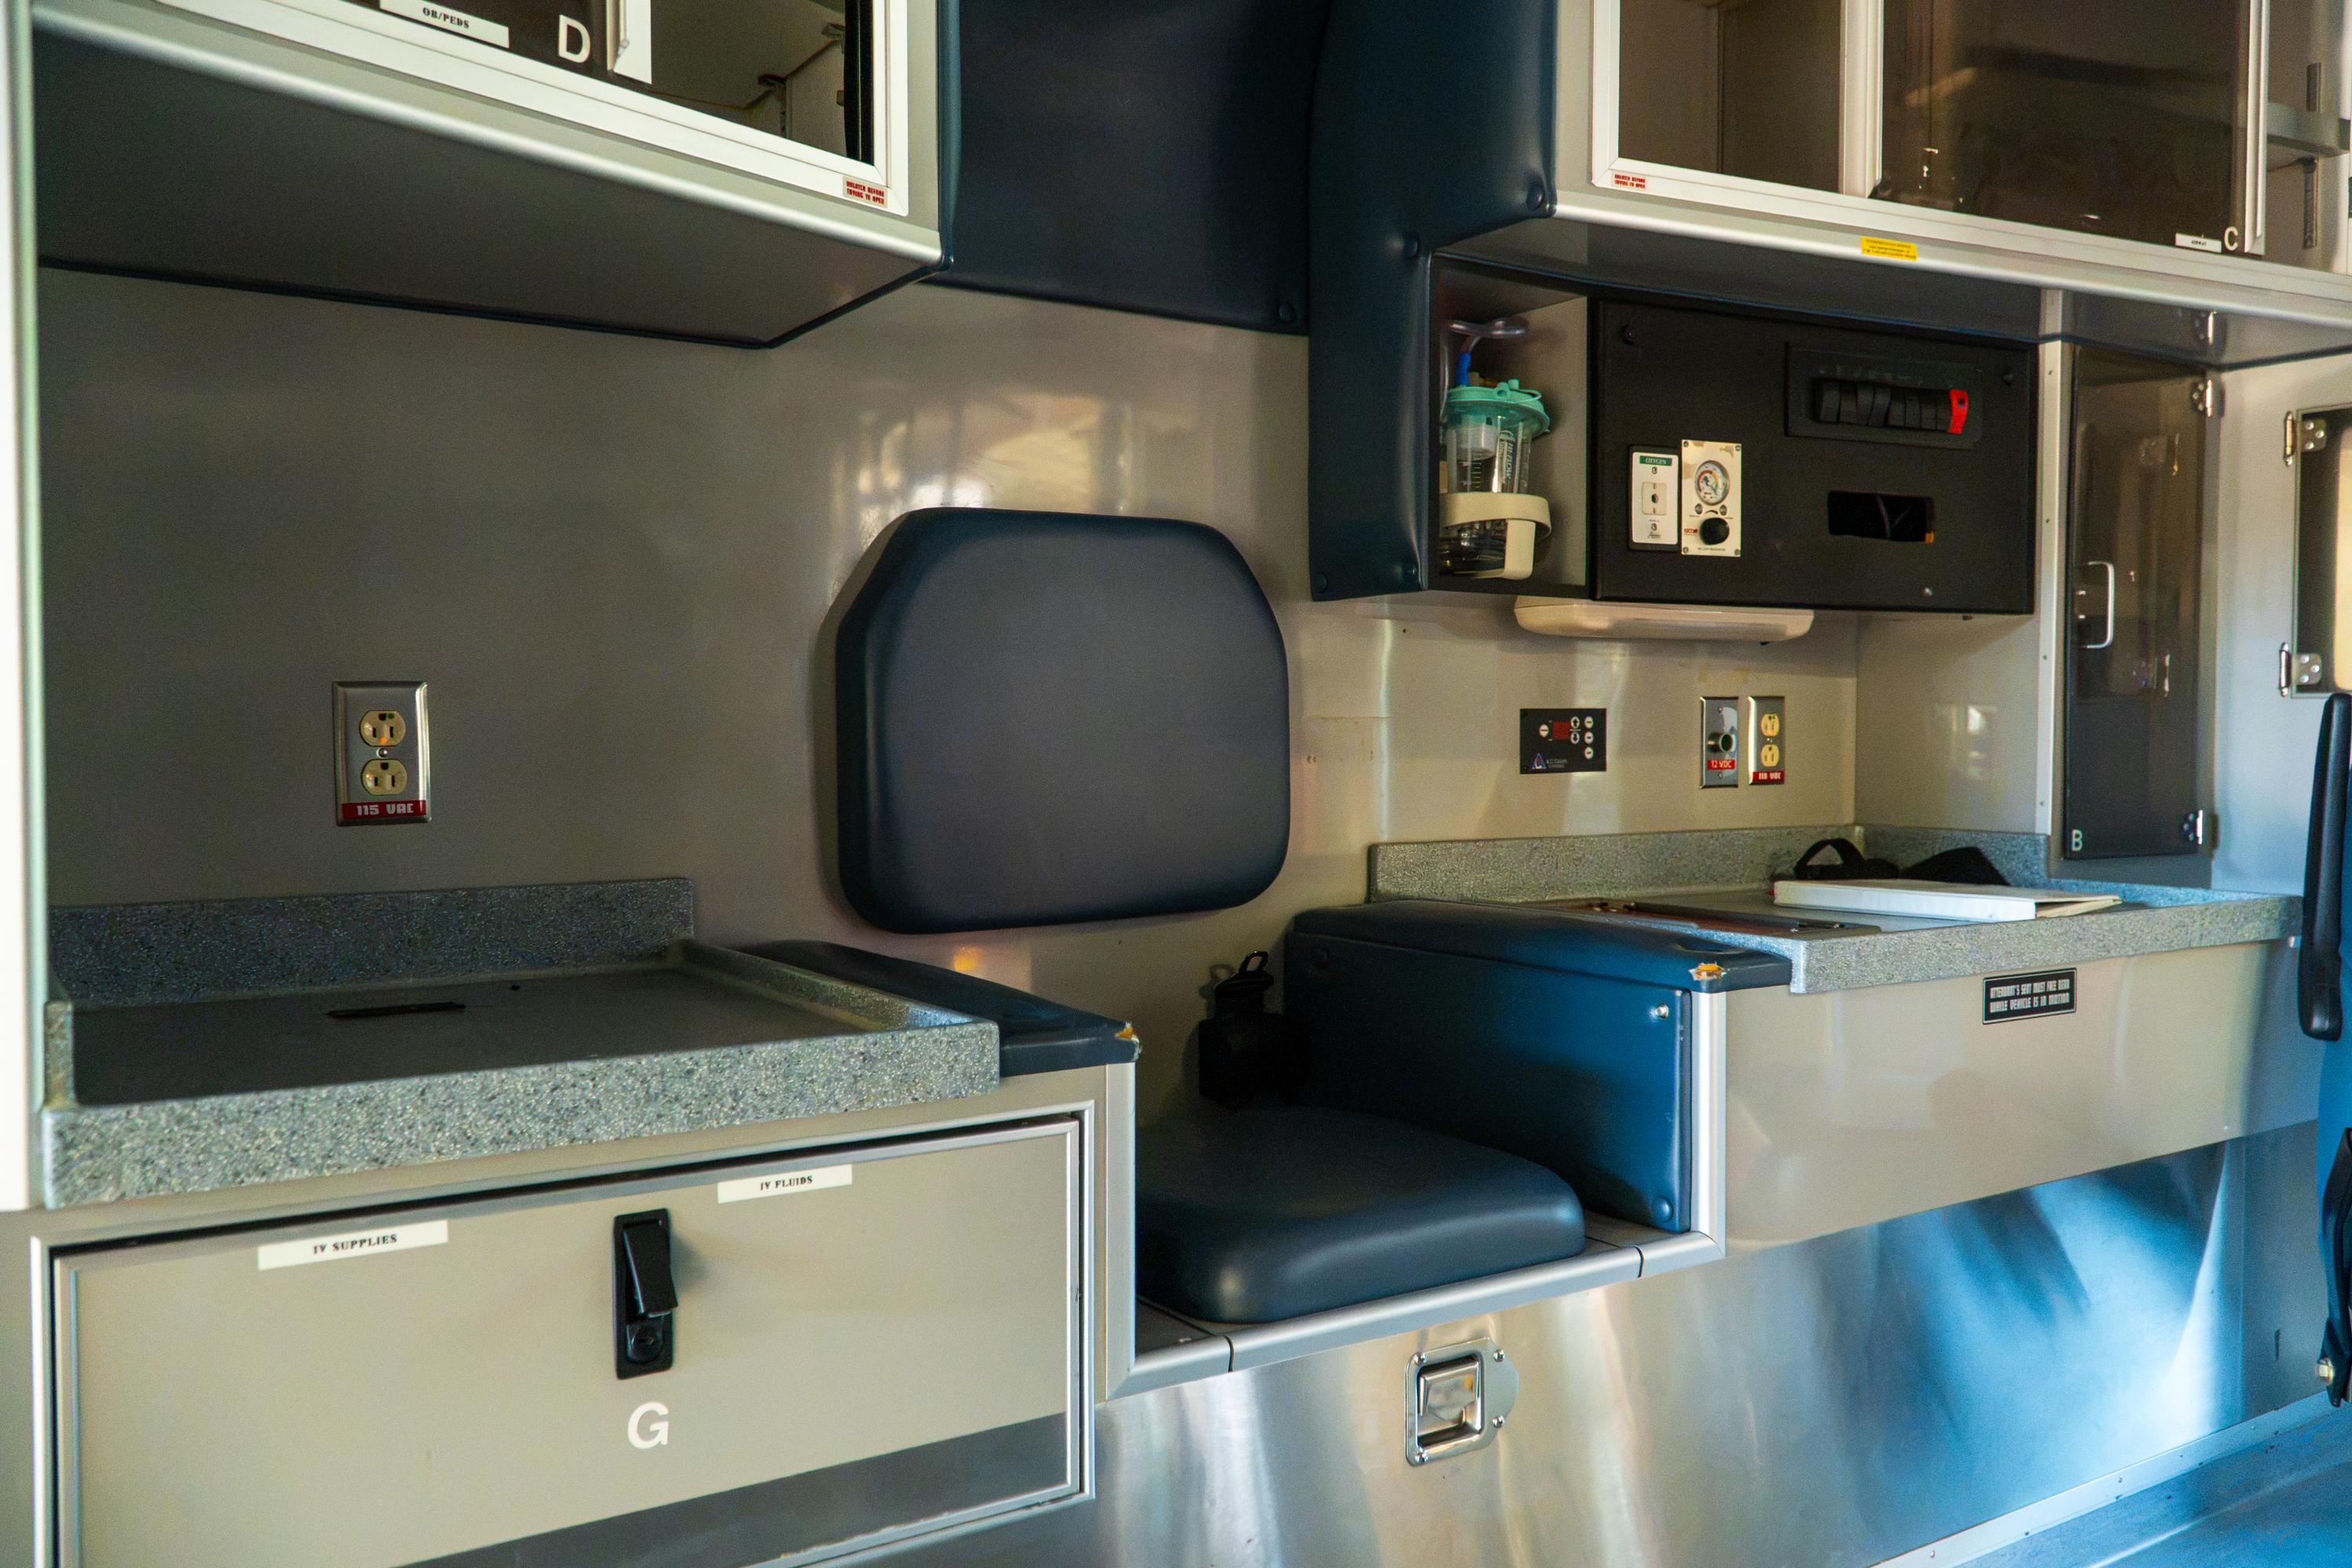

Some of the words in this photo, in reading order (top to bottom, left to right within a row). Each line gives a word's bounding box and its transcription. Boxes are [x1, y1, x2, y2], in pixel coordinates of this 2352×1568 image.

[422, 6, 470, 29] OB/PEDS
[558, 14, 590, 64] D
[2224, 226, 2238, 251] C
[356, 804, 379, 815] 115
[386, 803, 413, 815] VAC
[2071, 829, 2082, 851] B
[2009, 997, 2031, 1010] VEHICLE
[2033, 996, 2039, 1007] IS
[760, 1181, 771, 1190] IV
[775, 1175, 813, 1189] FLUIDS
[313, 1244, 327, 1254] IV
[332, 1233, 397, 1252] SUPPLIES
[627, 1401, 669, 1450] G
